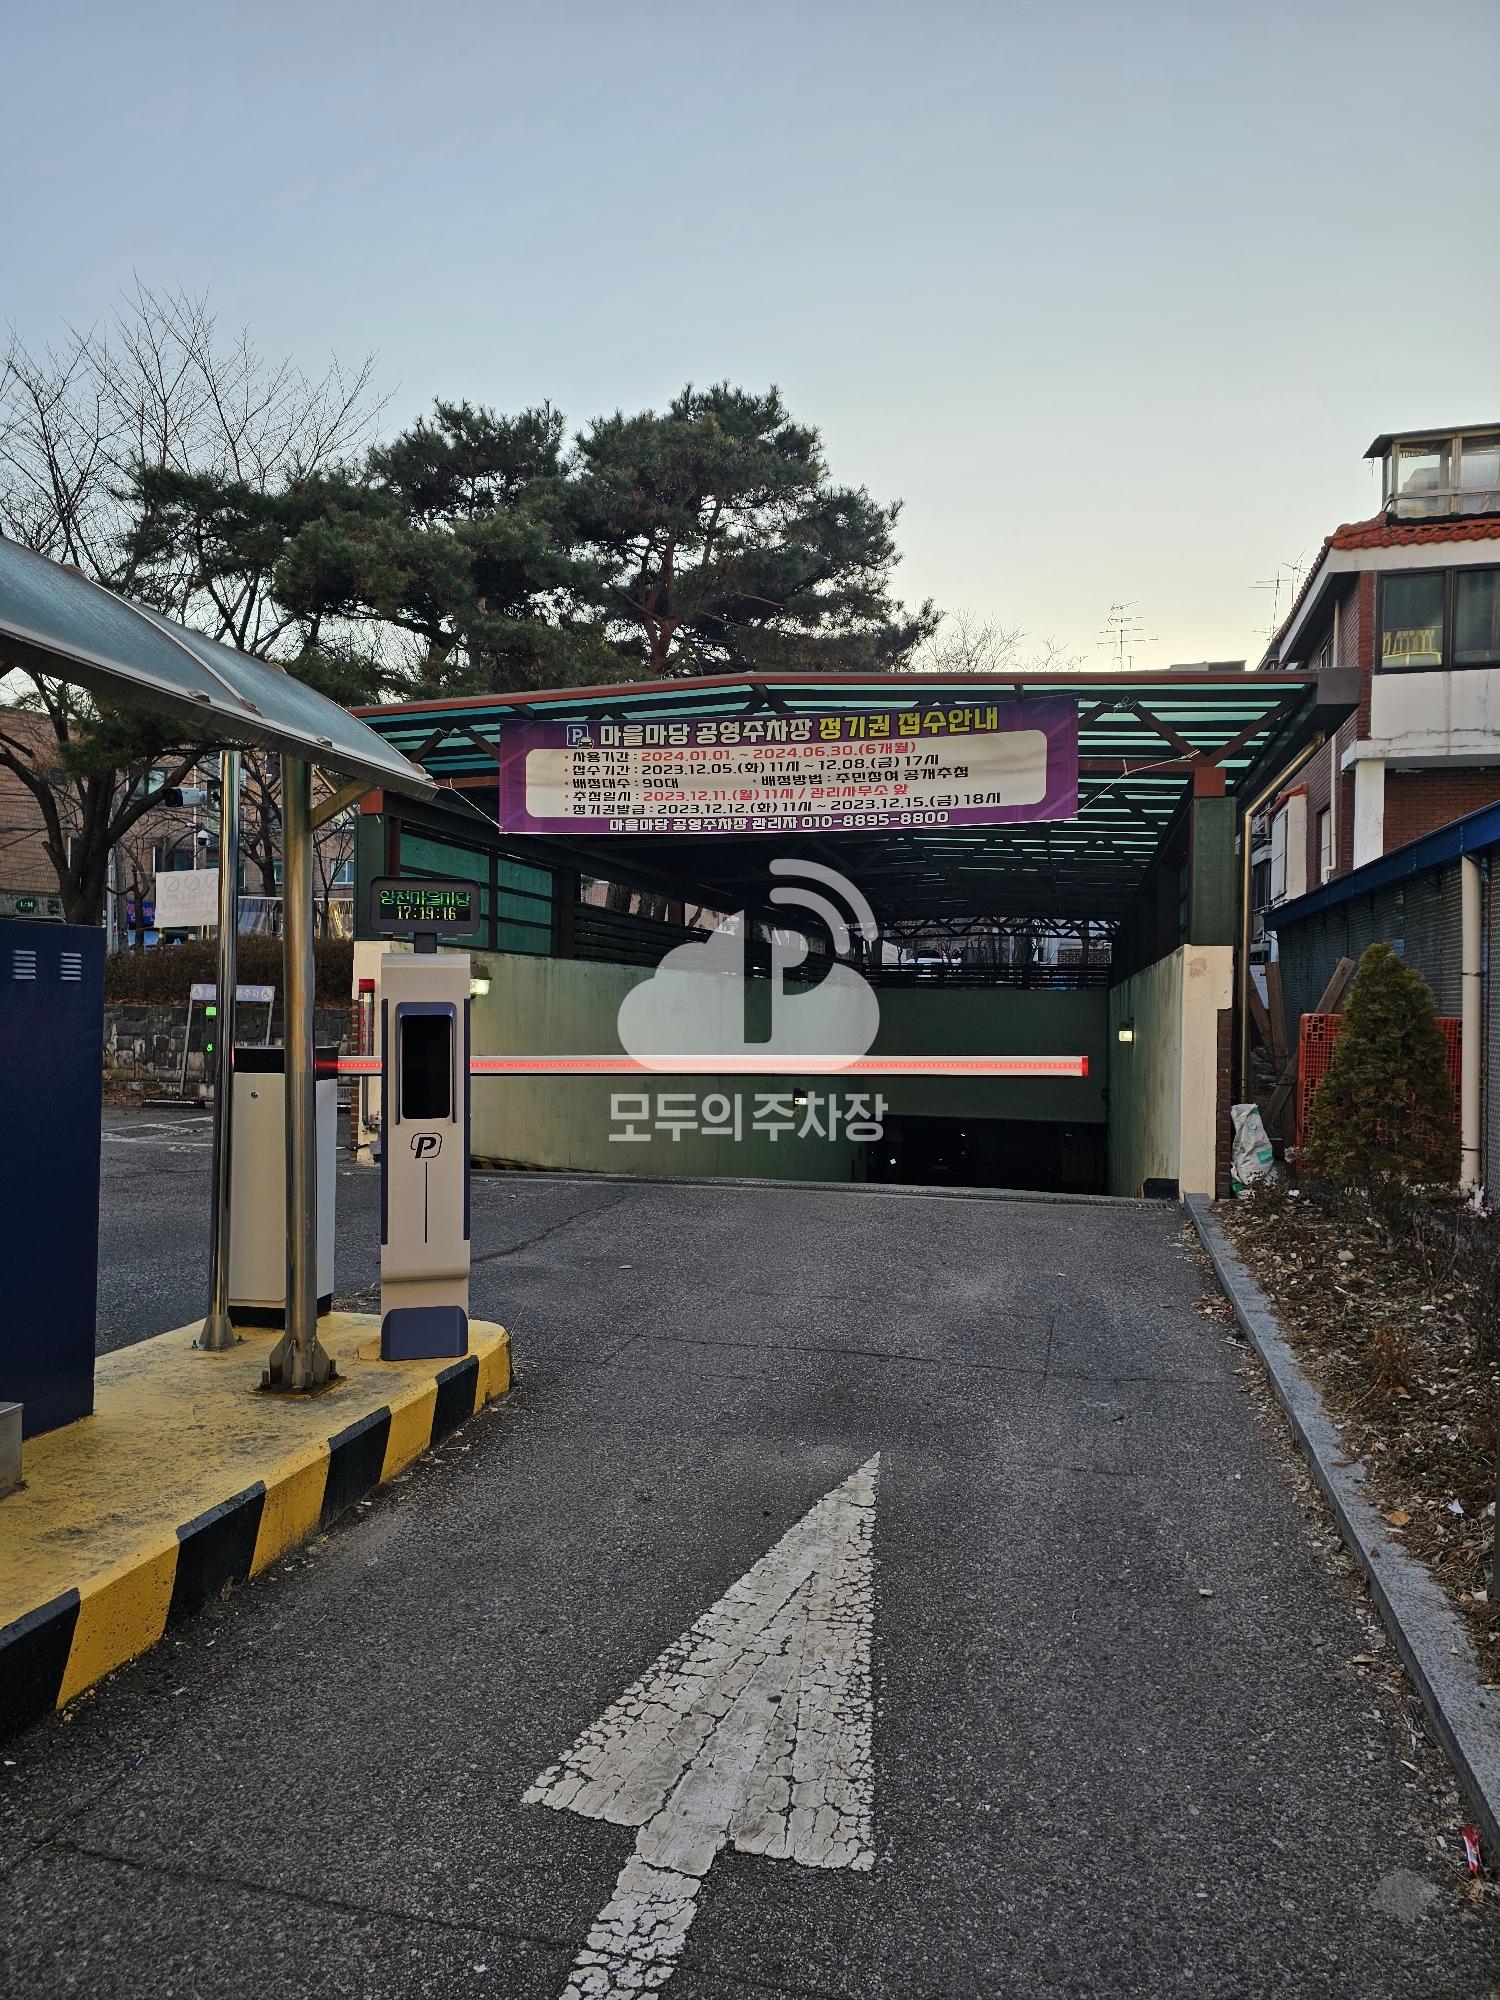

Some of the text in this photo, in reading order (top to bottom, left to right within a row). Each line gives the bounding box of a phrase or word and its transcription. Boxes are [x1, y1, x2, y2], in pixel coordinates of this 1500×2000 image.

[600, 724, 691, 747] 마을마당
[696, 719, 813, 746] 공영주차장
[819, 714, 890, 740] 정기권
[898, 706, 998, 736] 접수안내
[572, 751, 630, 763] 사용기간
[641, 749, 735, 762] 2024.01.01.
[753, 741, 916, 760] 2024.06.30.(6개월)
[572, 764, 630, 776] 접수기간
[641, 762, 765, 775] 2023.12.05.(화)
[769, 760, 800, 773] 11시
[818, 756, 900, 771] 12.08.(금)
[904, 754, 939, 767] 17시
[761, 774, 822, 787] 배정방법
[836, 770, 899, 784] 주민참여
[903, 765, 969, 781] 공개추첨
[572, 778, 631, 789] 배정대수
[642, 777, 679, 789] 90대
[572, 790, 631, 802] 추첨일시
[643, 788, 760, 802] 2023.12.11.(월)
[764, 788, 794, 800] 11시
[810, 784, 889, 799] 관리사무소
[893, 783, 909, 795] 앞
[572, 804, 646, 815] 정기권발급
[657, 802, 778, 816] 2023.12.12.(화)
[781, 801, 812, 812] 11시
[830, 794, 959, 812] 2023.12.15.(금)
[963, 792, 1001, 805] 18시
[609, 811, 950, 832] 마을마당 공영주차장 관리자 010-8895-8800
